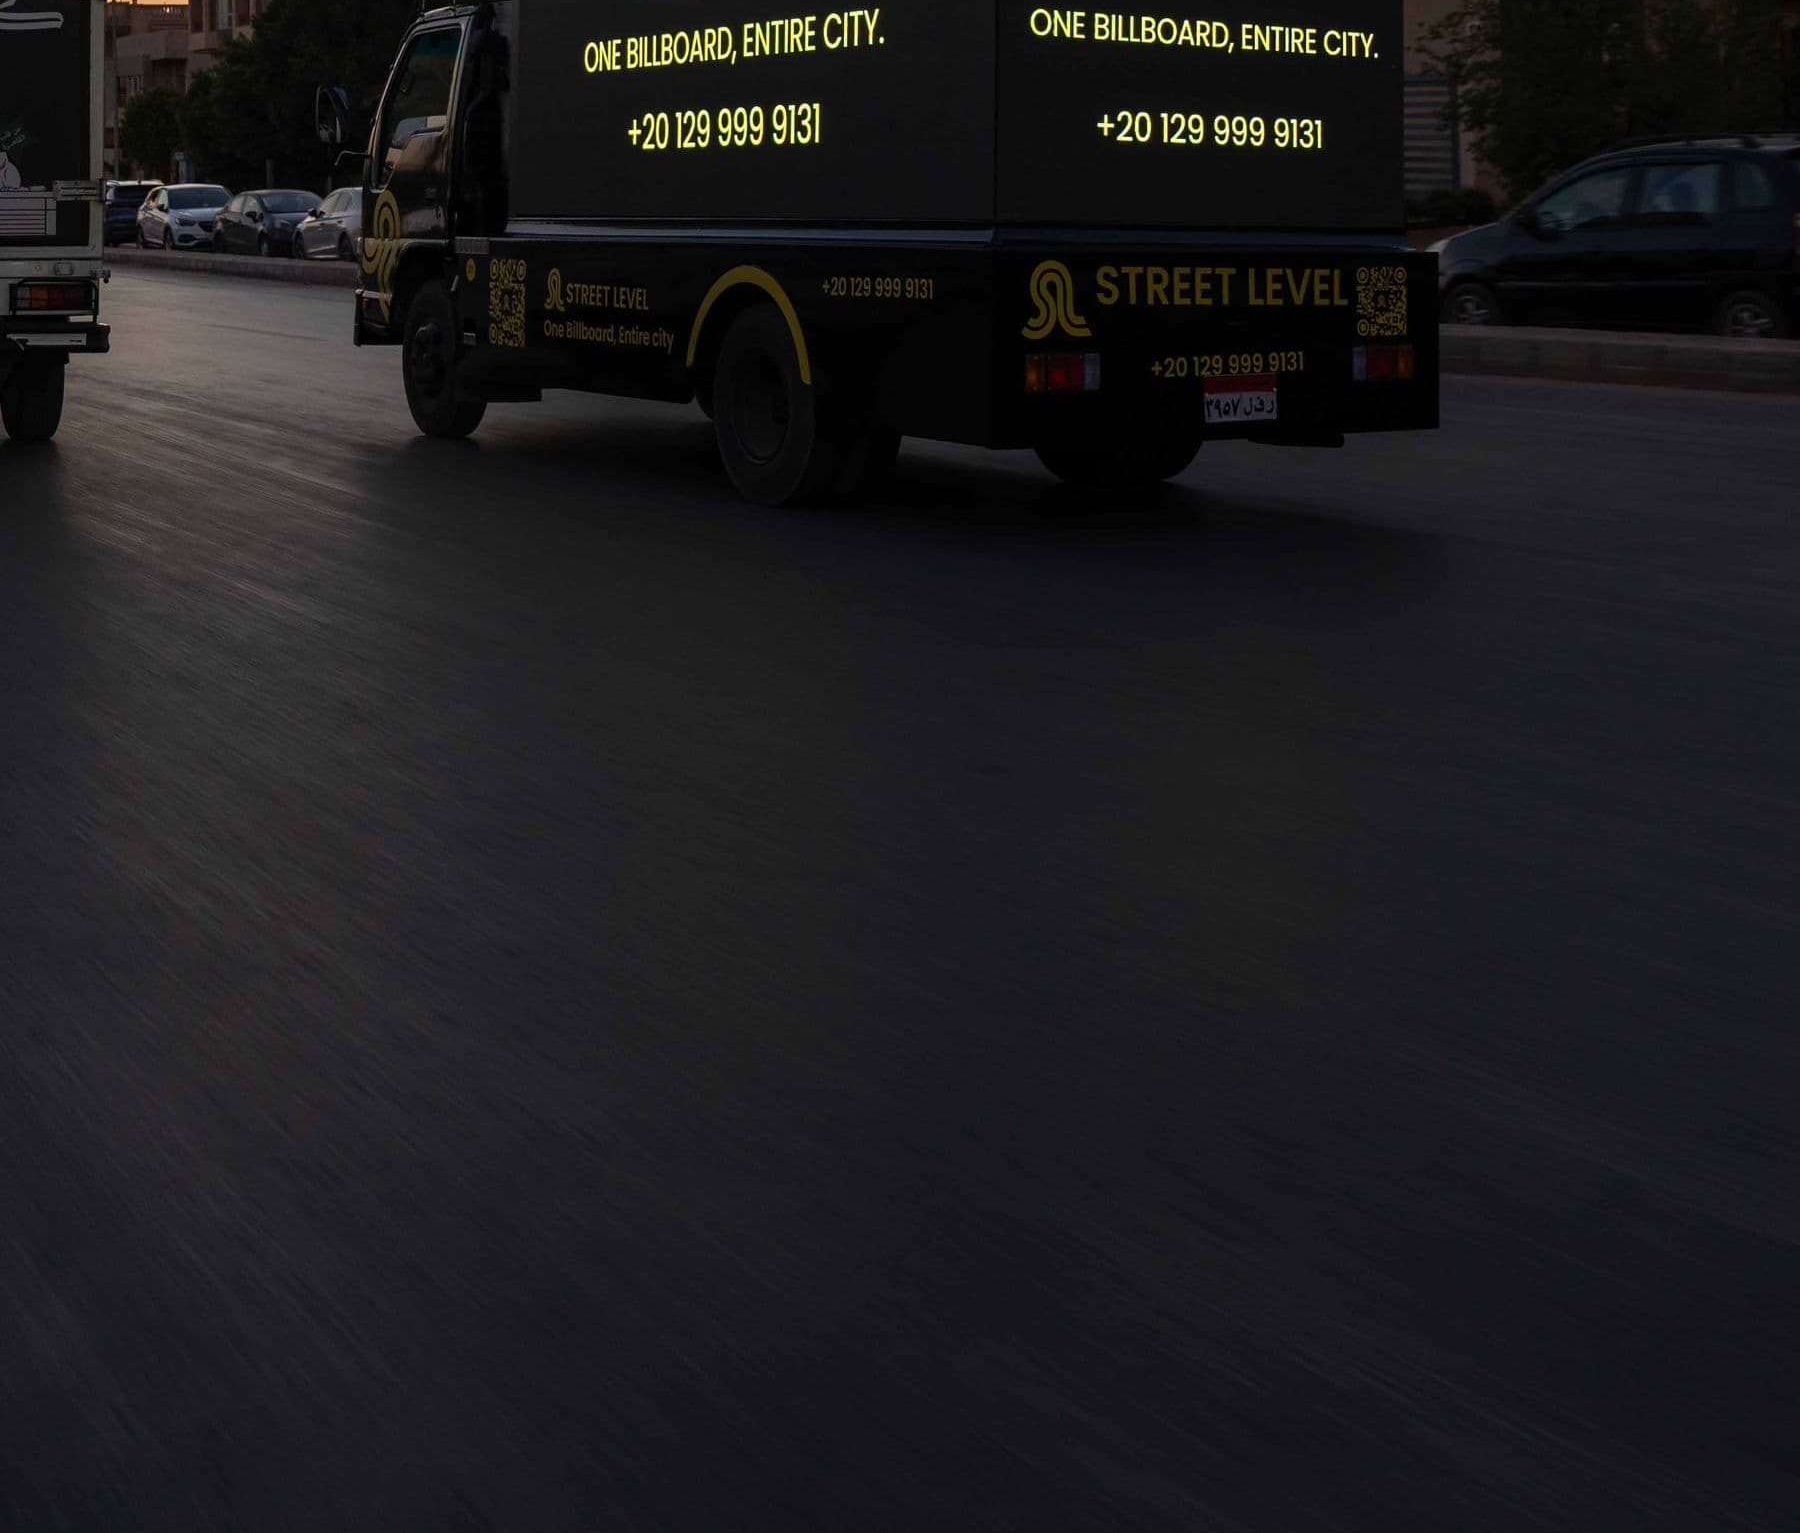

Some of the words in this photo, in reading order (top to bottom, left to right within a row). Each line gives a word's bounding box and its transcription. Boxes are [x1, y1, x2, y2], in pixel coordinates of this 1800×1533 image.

[584, 38, 622, 73] ONE
[626, 26, 737, 69] BILLBOARD,
[743, 15, 817, 58] ENTIRE
[823, 8, 886, 49] CITY.
[1030, 8, 1086, 39] ONE
[1094, 12, 1235, 54] BILLBOARD,
[1241, 23, 1317, 55] ENTIRE
[1323, 29, 1379, 59] CITY.
[627, 112, 670, 150] +20
[675, 109, 711, 149] 129
[717, 105, 764, 147] 999
[772, 102, 820, 145] 9131
[1096, 110, 1152, 143] +20
[1160, 112, 1204, 144] 129
[1213, 114, 1265, 147] 999
[1273, 117, 1322, 149] 9131
[566, 282, 611, 307] STREET
[613, 286, 649, 310] LEVEL
[822, 276, 847, 297] +20
[850, 277, 872, 297] 129
[875, 277, 902, 298] 999
[905, 278, 934, 300] 9131
[1096, 266, 1236, 305] STREET
[1248, 268, 1349, 306] LEVEL
[543, 319, 564, 338] One
[566, 321, 616, 343] Billboard,
[618, 326, 650, 346] Entire
[651, 328, 675, 355] city
[1151, 358, 1188, 378] +20
[1192, 356, 1223, 377] 129
[1229, 354, 1263, 375] 999
[1268, 351, 1305, 373] 9131
